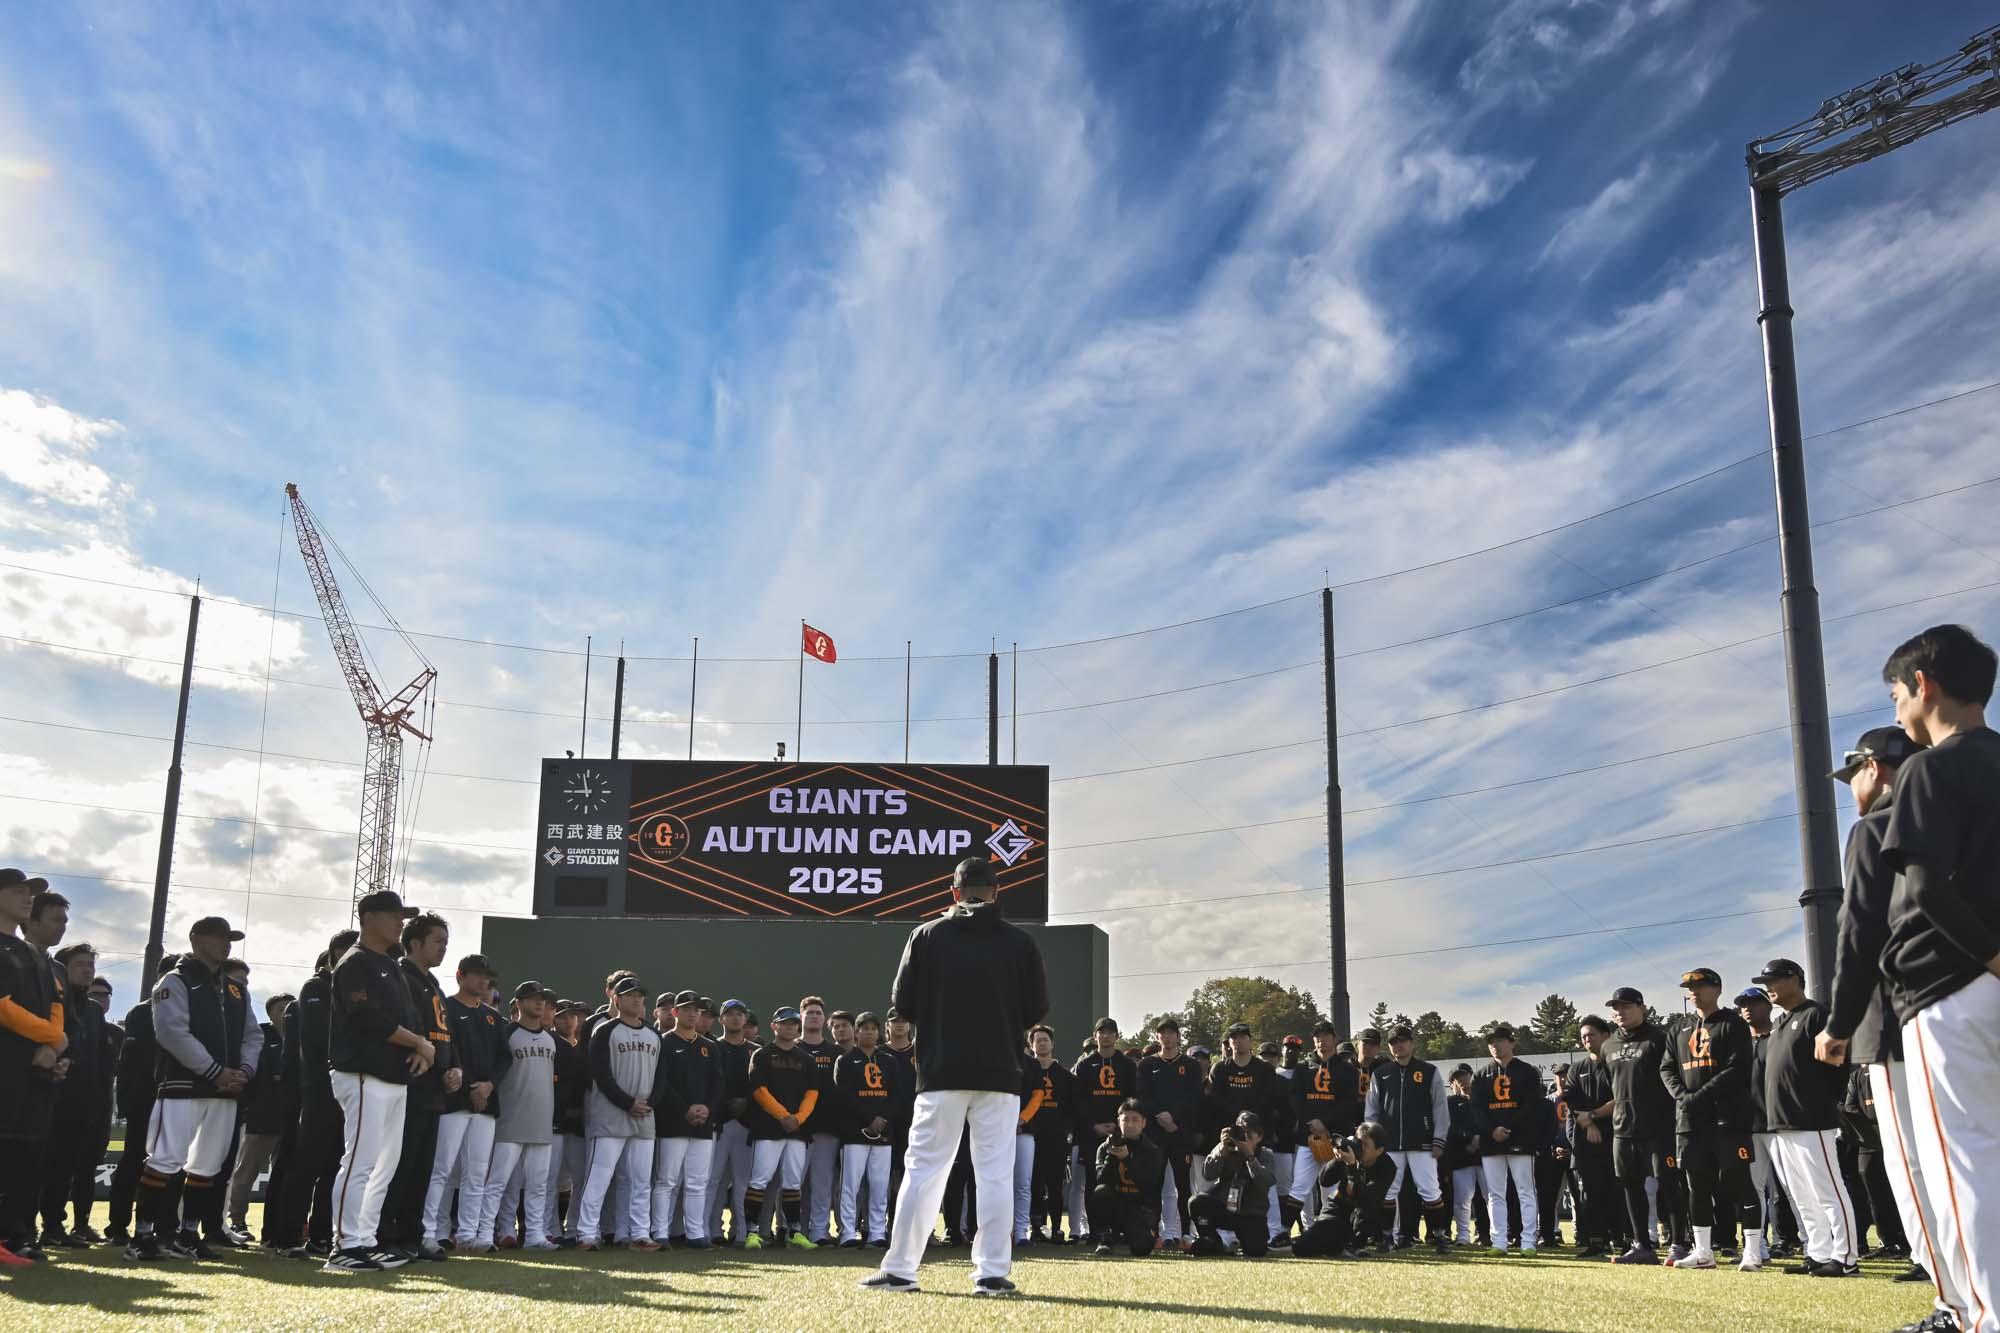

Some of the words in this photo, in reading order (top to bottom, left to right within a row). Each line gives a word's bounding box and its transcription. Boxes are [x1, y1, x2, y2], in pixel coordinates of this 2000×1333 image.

[769, 787, 908, 816] GIANTS
[547, 823, 623, 841] 西武建設
[655, 822, 673, 847] G
[702, 825, 859, 855] AUTUMN
[868, 828, 972, 856] CAMP
[566, 855, 619, 866] STADIUM
[567, 848, 596, 856] GIANTS
[597, 848, 620, 856] TOWN
[788, 867, 883, 895] 2025
[618, 1040, 657, 1057] GIANTS
[1688, 1026, 1711, 1058] G
[864, 1062, 882, 1089] G
[1099, 1065, 1115, 1088] G
[1314, 1067, 1331, 1092] G
[1493, 1075, 1511, 1102] G
[1737, 1146, 1749, 1160] G
